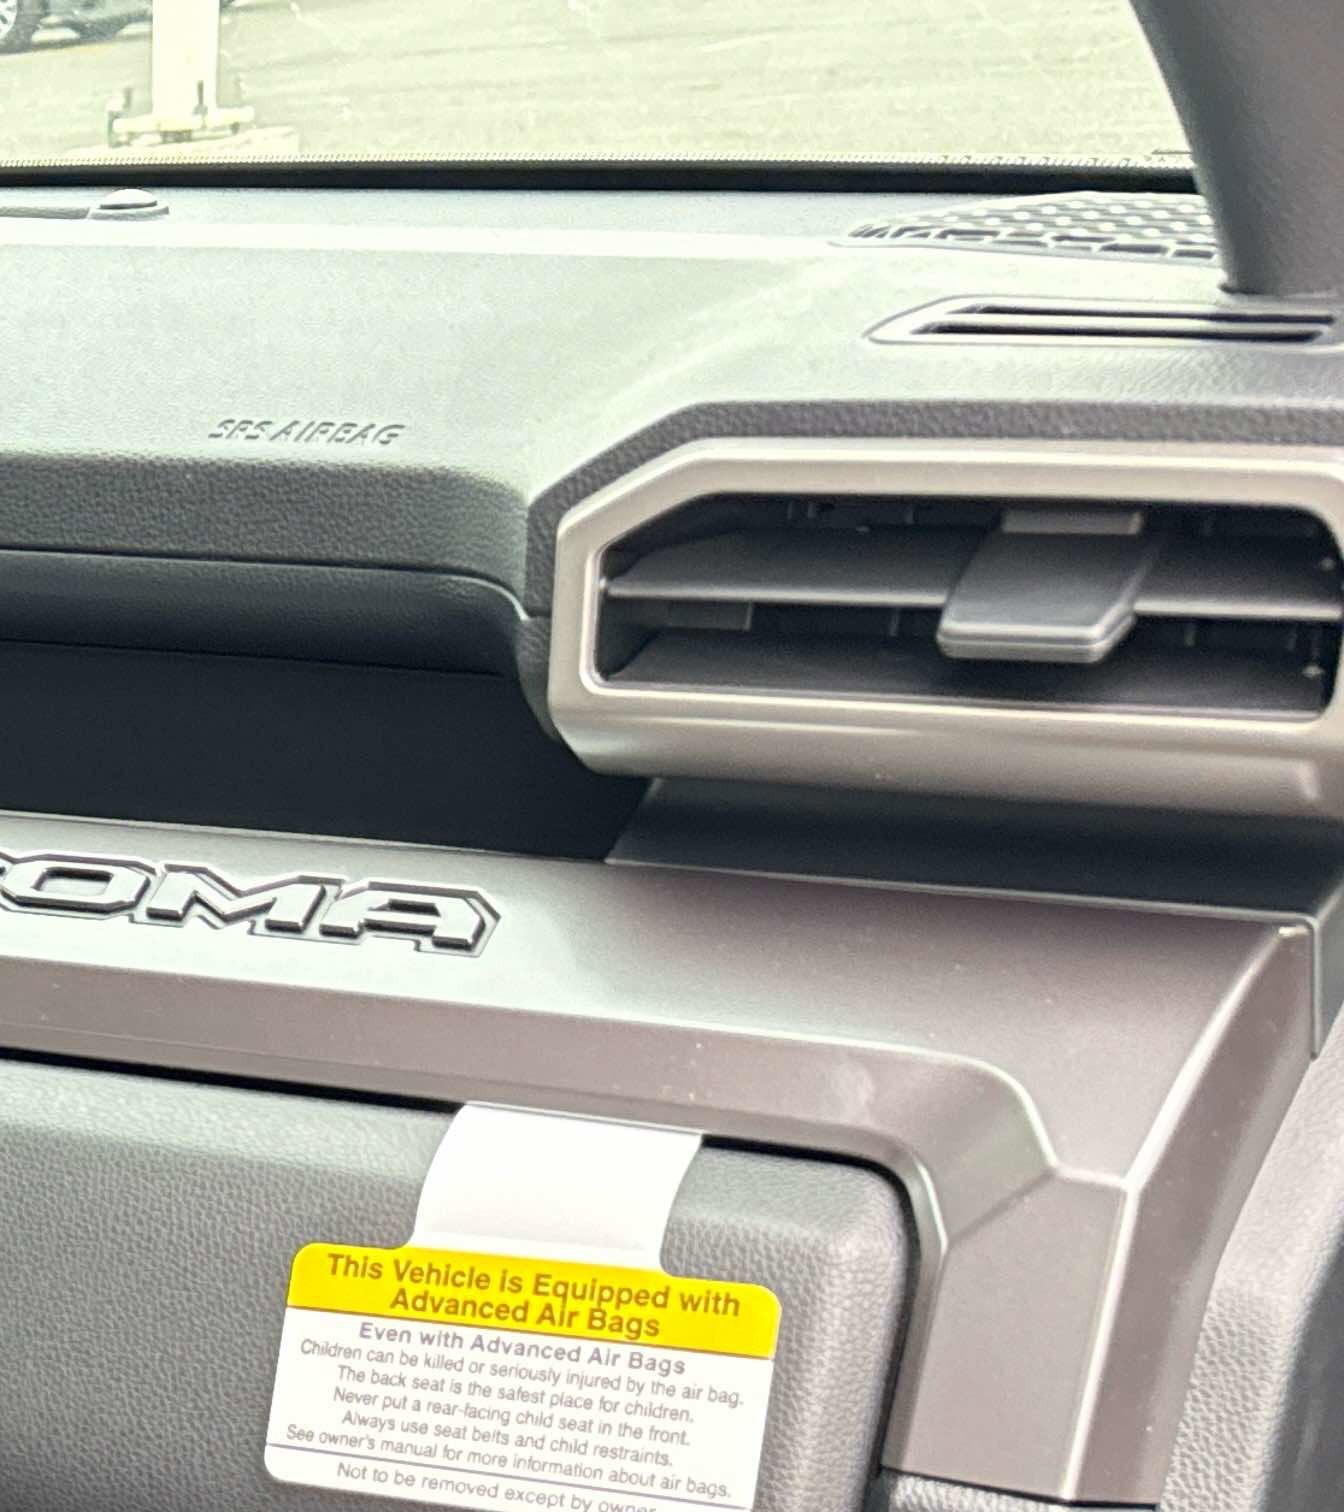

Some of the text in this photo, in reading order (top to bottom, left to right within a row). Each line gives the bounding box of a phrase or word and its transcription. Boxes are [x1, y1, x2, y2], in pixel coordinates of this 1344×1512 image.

[269, 419, 407, 446] AIRBAG
[327, 1252, 741, 1317] This Vehicle is Equipped with
[389, 1287, 660, 1340] Advanced Air Bags
[300, 1338, 744, 1409] Children can be killed or seriously injured by the air bag.
[358, 1321, 686, 1377] Even with Advanced Air Bags
[333, 1385, 690, 1447] Never put a rear-facing child seat in the front.
[337, 1364, 694, 1423] The back seat is the safest place for children.
[286, 1423, 731, 1500] See owner's manual for more information about air bags.
[341, 1409, 673, 1467] Always use seat belts and child restraints.
[336, 1461, 368, 1481] Not
[372, 1468, 389, 1484] to
[393, 1469, 417, 1488] be
[420, 1476, 500, 1499] removed
[504, 1488, 566, 1509] except
